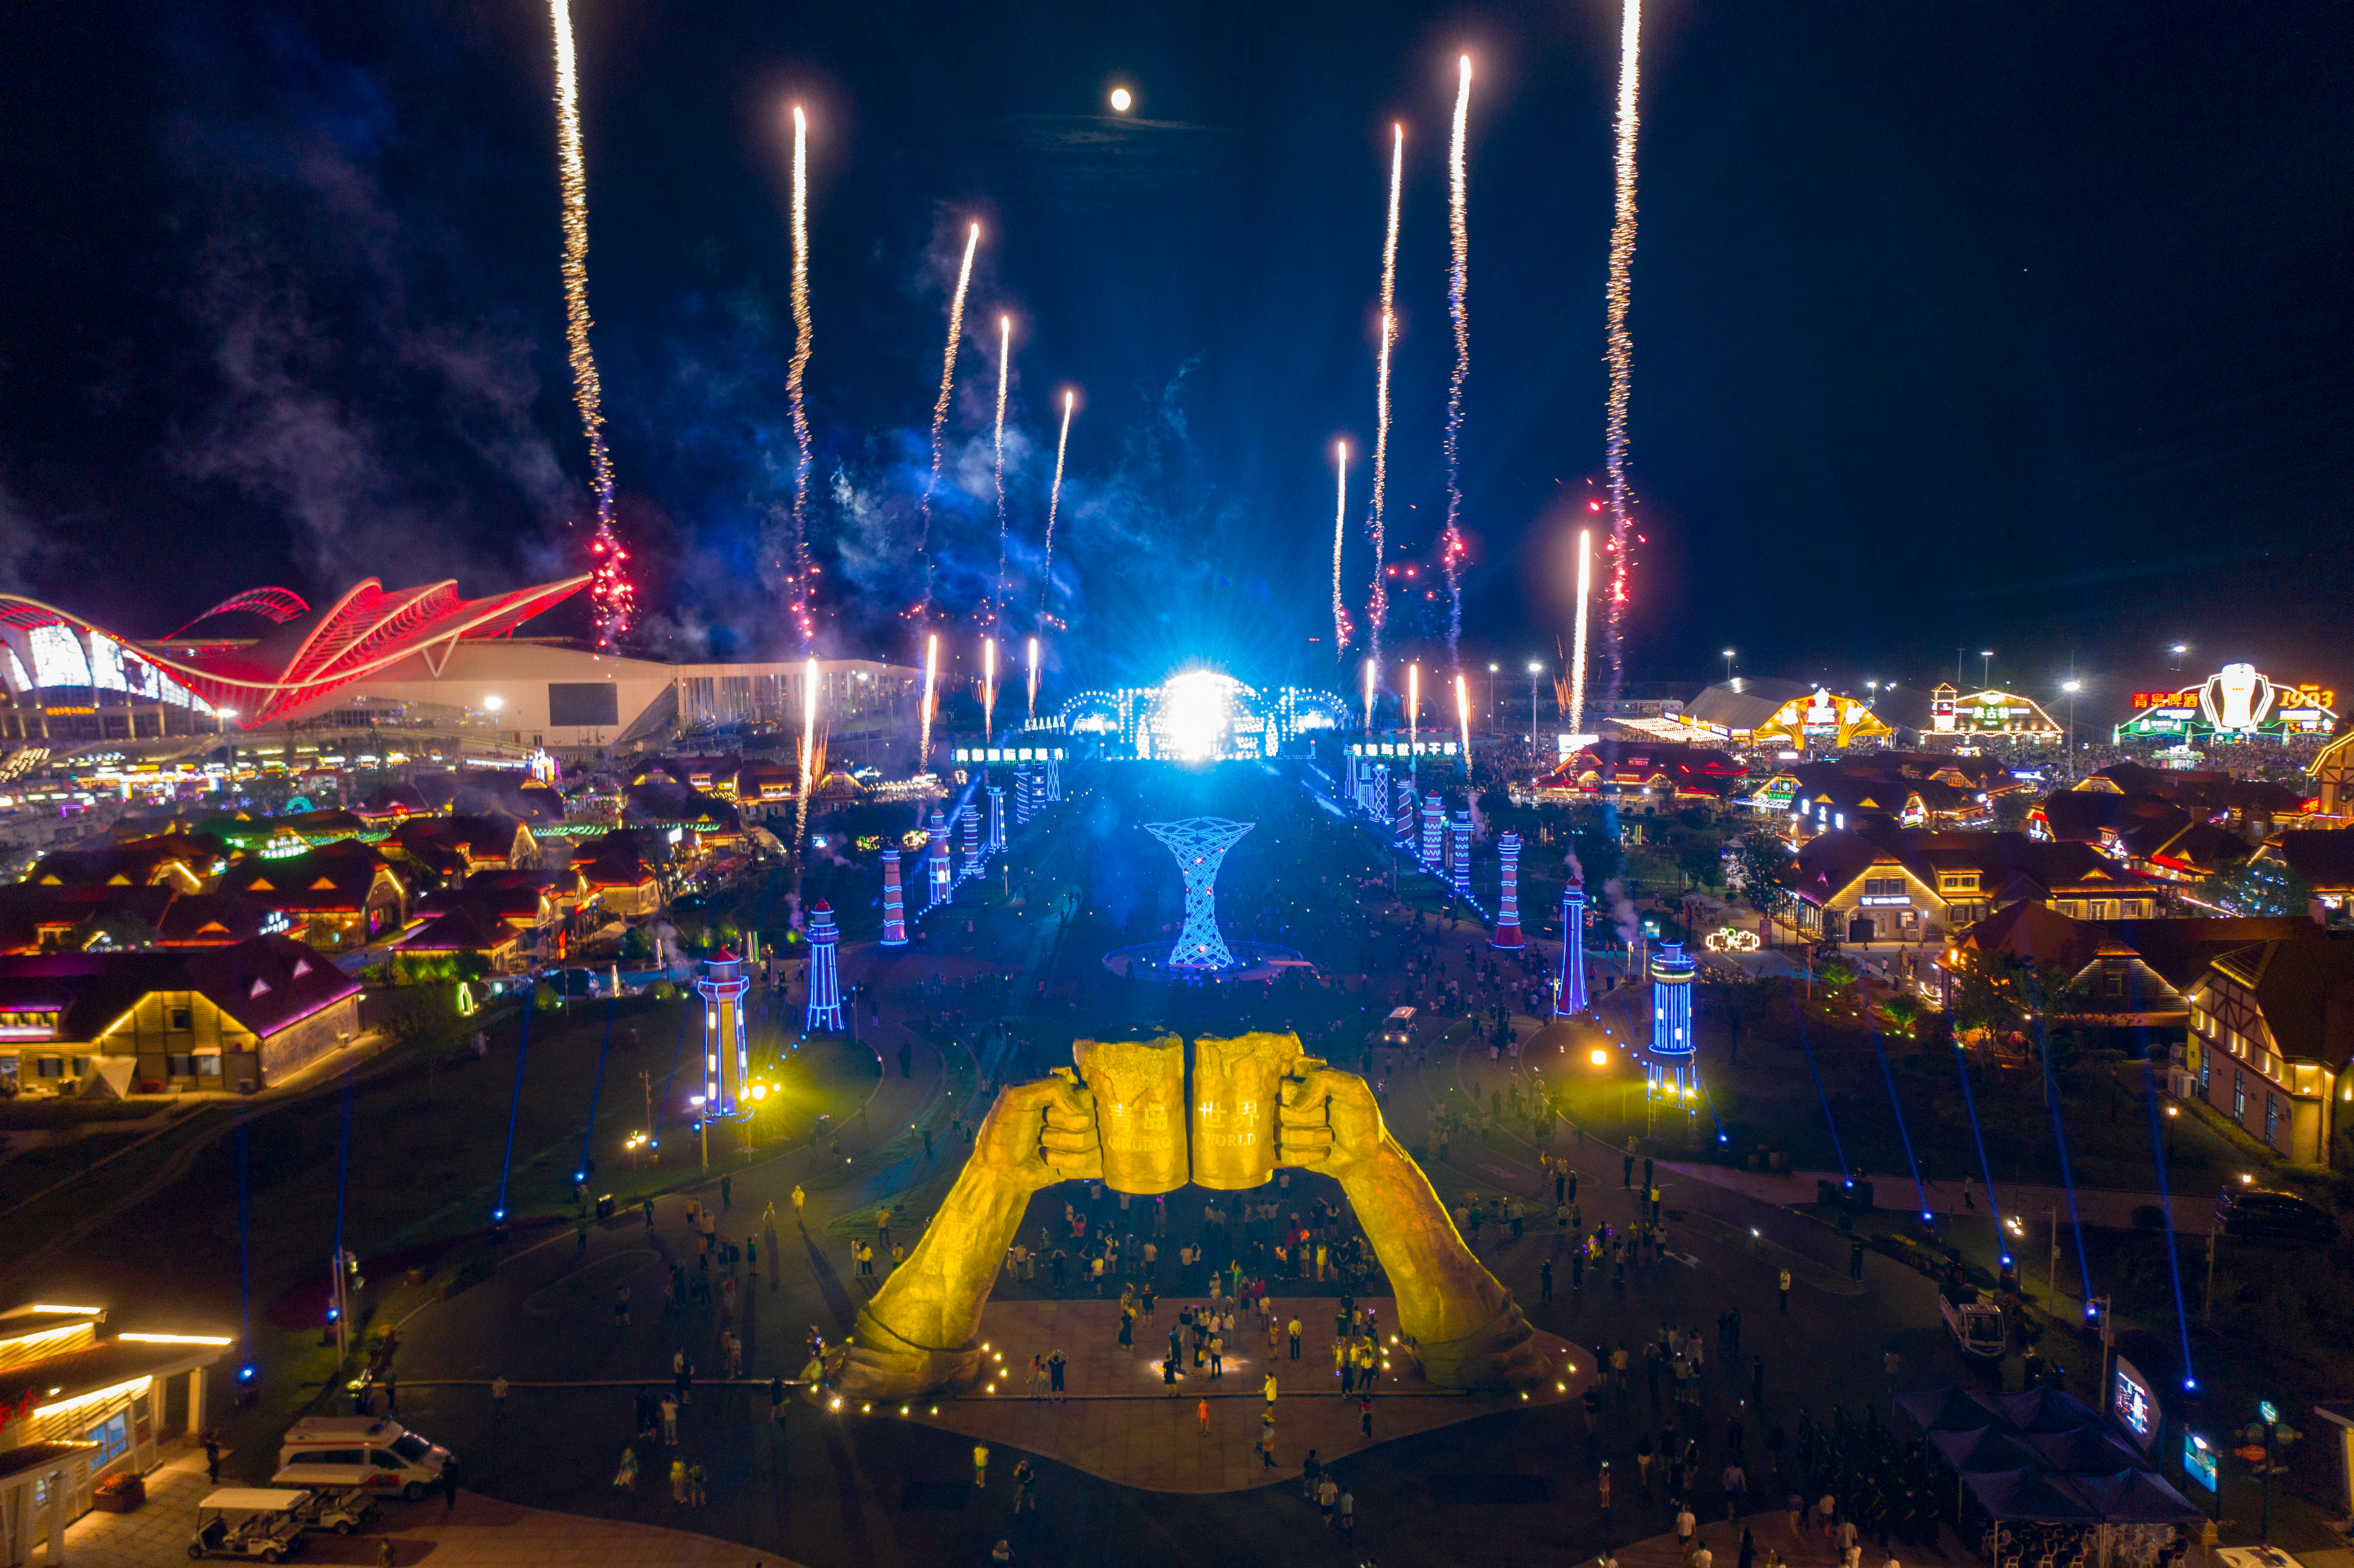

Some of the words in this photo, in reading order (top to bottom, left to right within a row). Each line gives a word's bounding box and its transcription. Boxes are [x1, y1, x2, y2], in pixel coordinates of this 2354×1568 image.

[2133, 693, 2198, 708] 青島啤酒
[2279, 691, 2334, 709] 1903
[1973, 706, 2010, 719] 奥古特
[1109, 1103, 1168, 1132] 青岛
[1198, 1101, 1260, 1128] 世界
[1108, 1136, 1172, 1151] QINGDAO
[1202, 1132, 1256, 1147] WORLD
